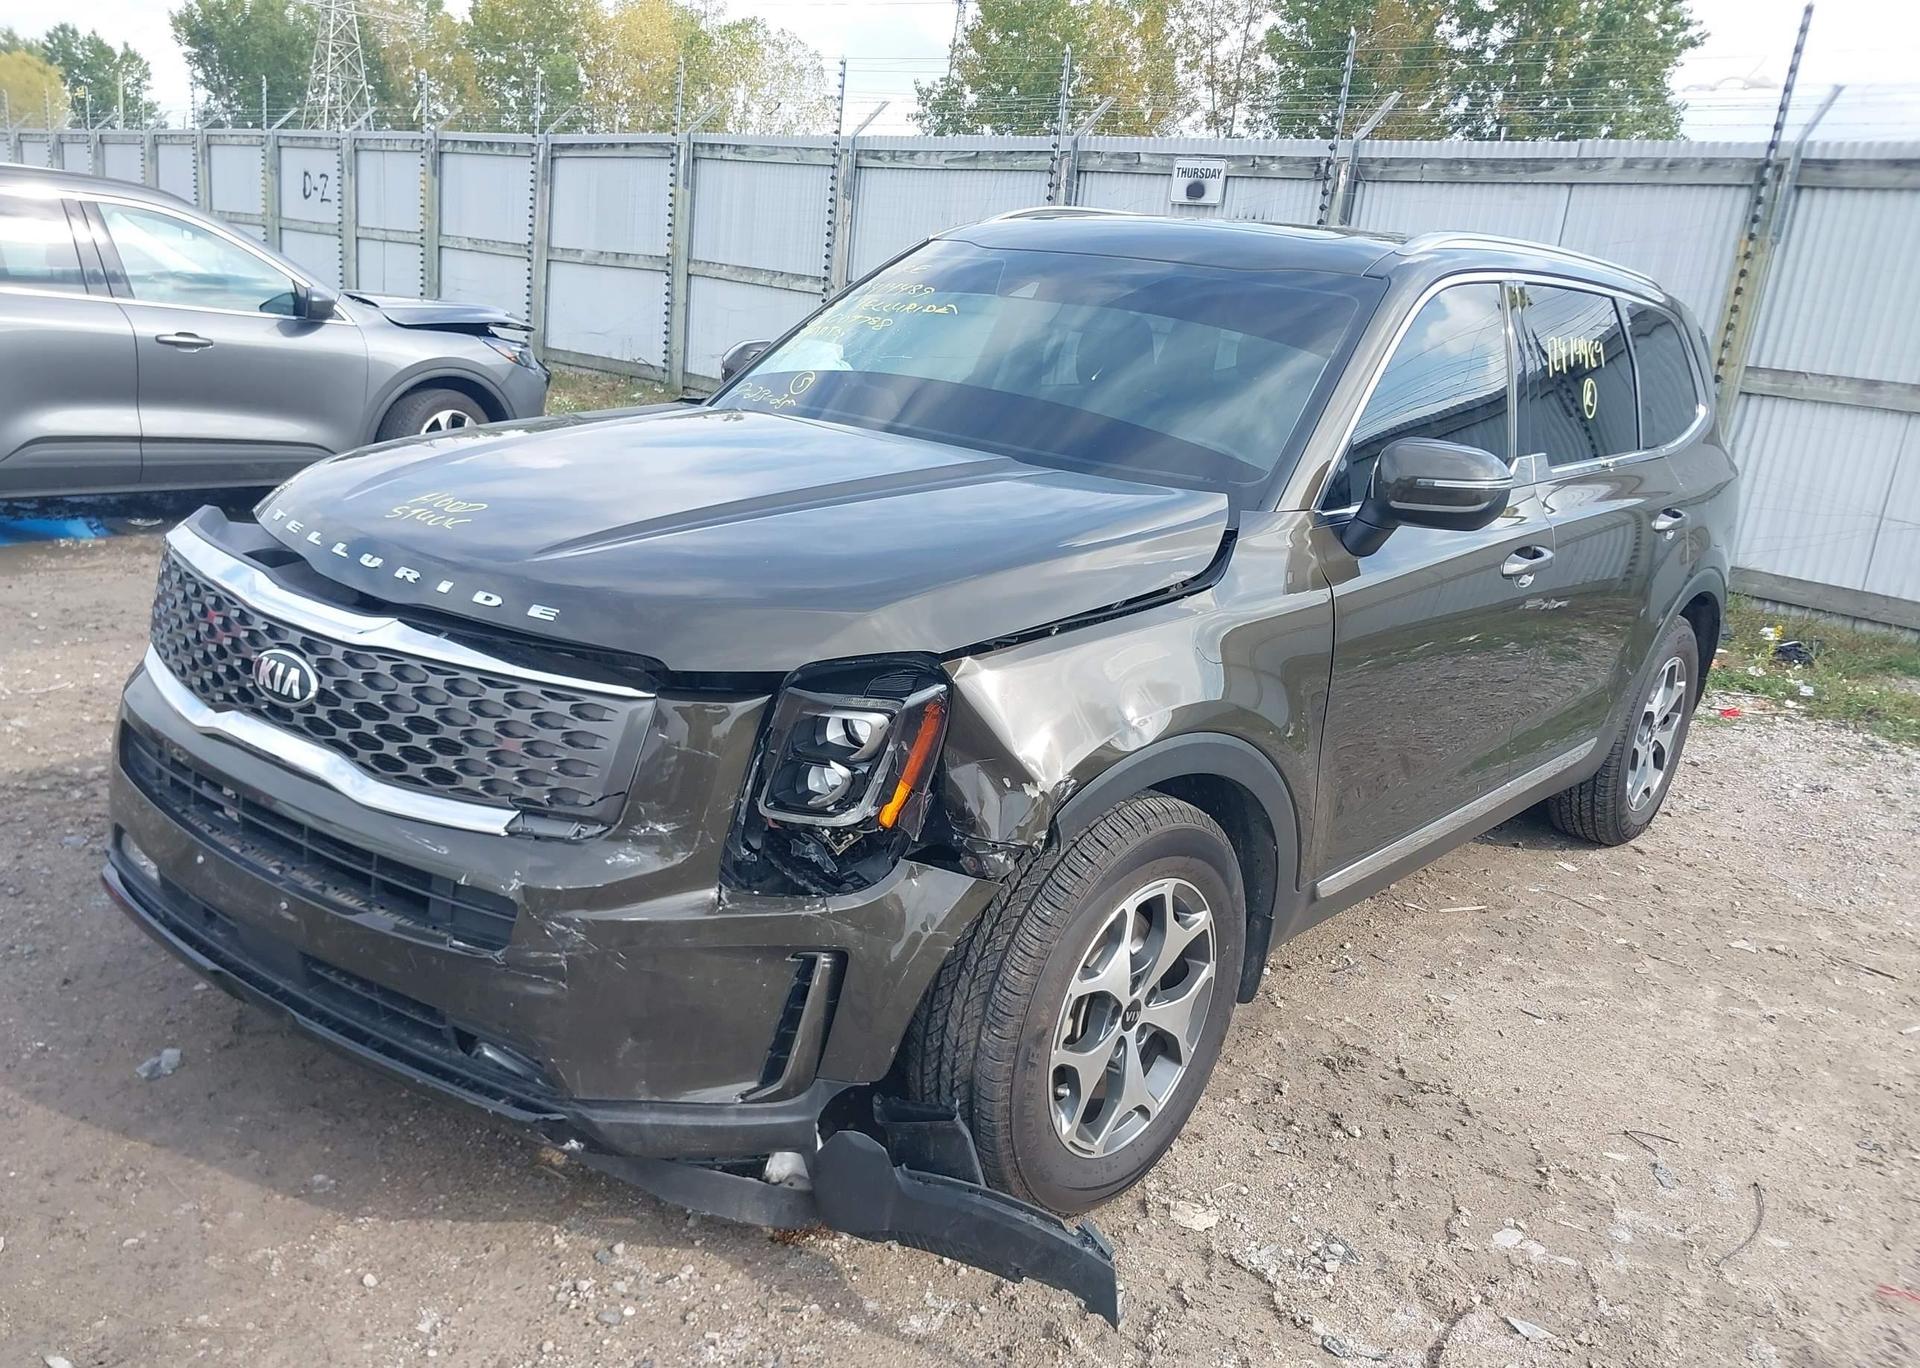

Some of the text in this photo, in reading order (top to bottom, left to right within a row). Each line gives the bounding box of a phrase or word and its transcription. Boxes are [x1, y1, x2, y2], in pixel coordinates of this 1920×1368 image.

[1176, 167, 1223, 179] THURSDAY
[272, 508, 561, 622] TELLURIDE
[257, 656, 302, 700] KIA
